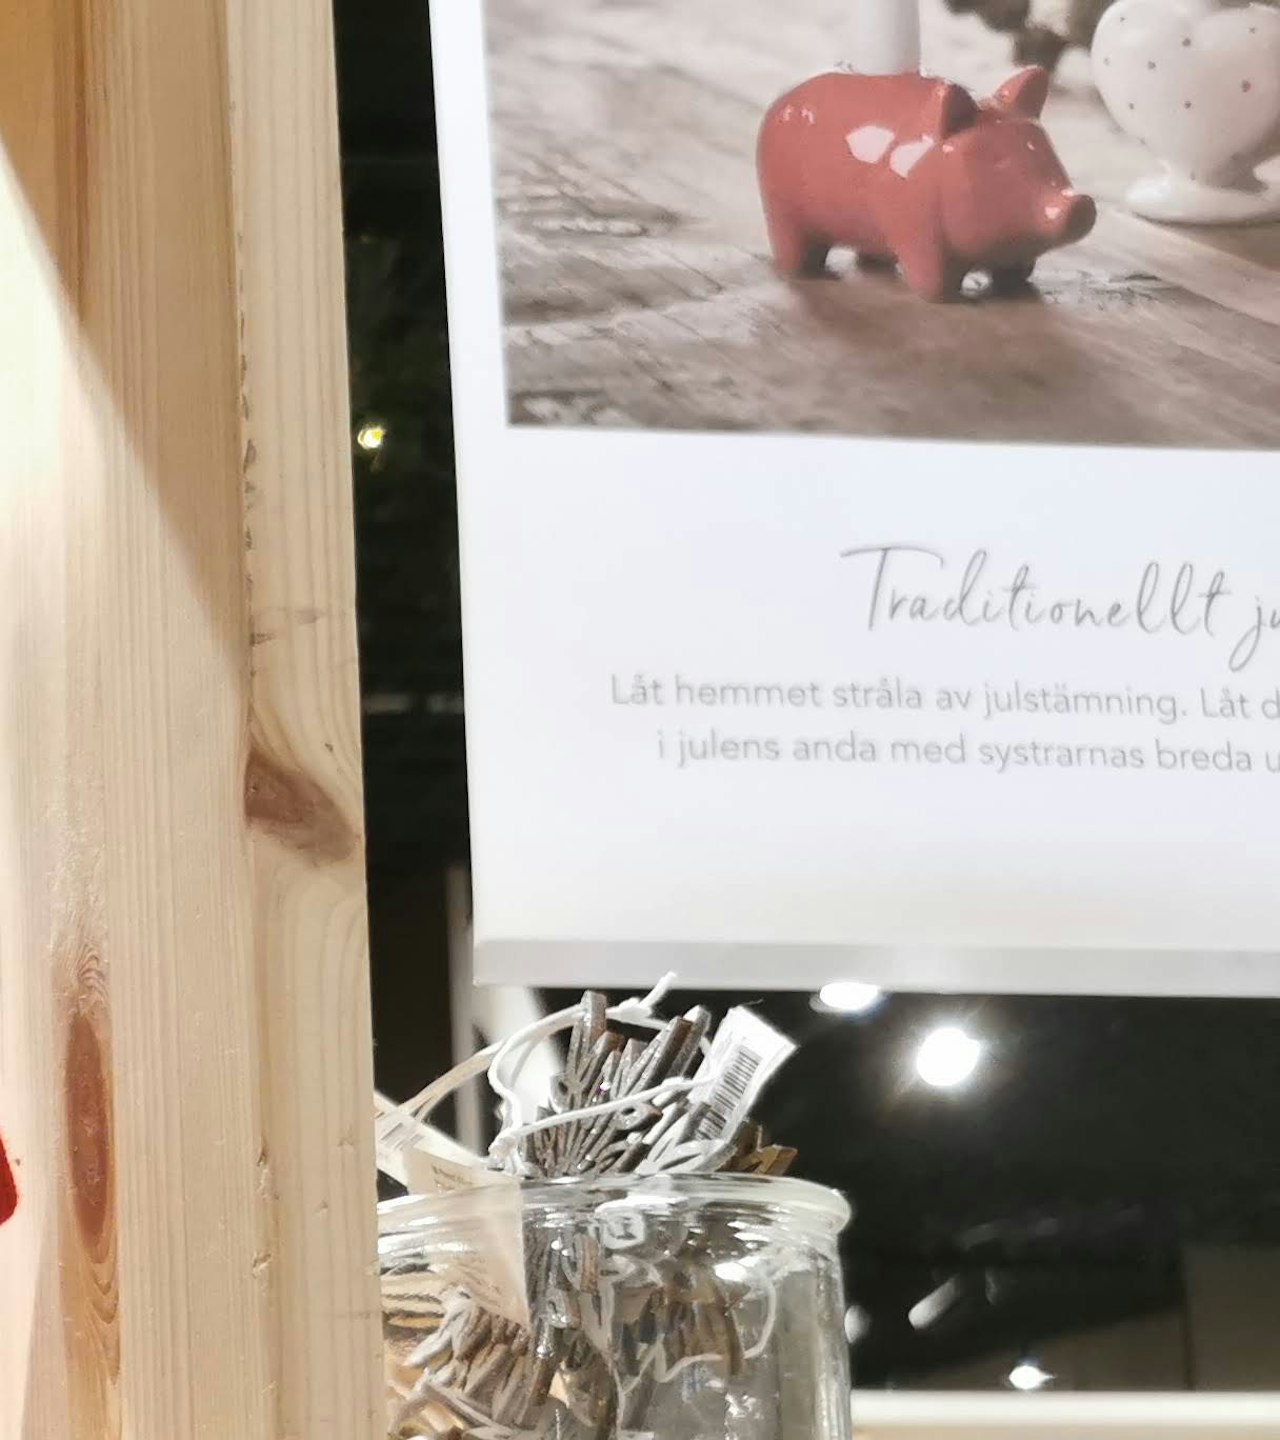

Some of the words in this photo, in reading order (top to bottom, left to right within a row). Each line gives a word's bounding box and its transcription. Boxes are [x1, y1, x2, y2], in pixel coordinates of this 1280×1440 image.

[839, 544, 1231, 637] Traditionellt
[611, 671, 663, 706] Låt
[675, 674, 823, 708] hemmet
[833, 676, 922, 710] stråla
[938, 687, 972, 712] av
[983, 680, 1188, 725] julstämning.
[1200, 686, 1251, 720] Låt
[657, 728, 665, 760] i
[677, 728, 781, 769] julens
[792, 730, 877, 763] anda
[890, 732, 966, 765] med
[978, 740, 1145, 775] systrarnas
[1155, 737, 1252, 773] breda
